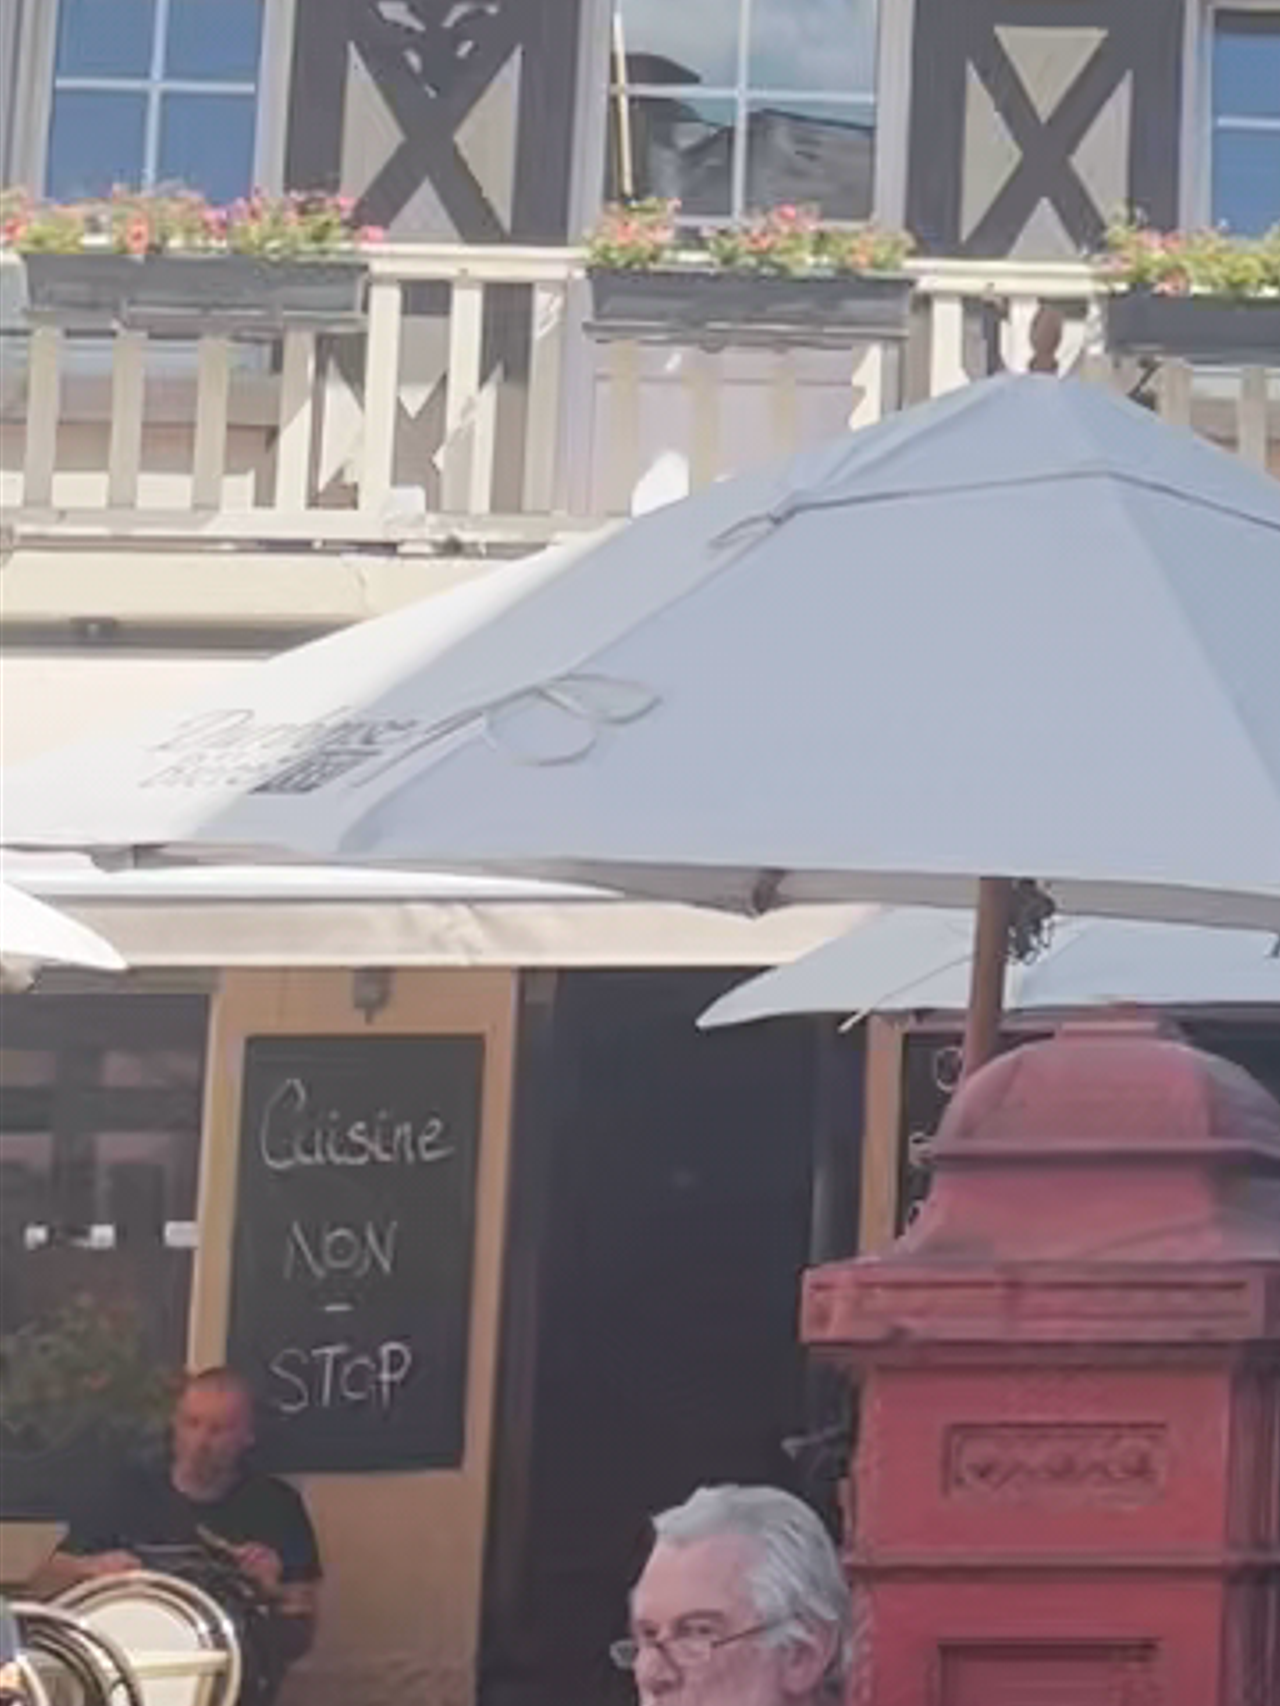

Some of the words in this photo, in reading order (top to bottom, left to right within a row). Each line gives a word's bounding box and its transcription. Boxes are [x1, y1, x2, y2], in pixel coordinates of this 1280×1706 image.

[261, 1077, 456, 1170] Cuisine
[284, 1220, 397, 1279] NON
[270, 1341, 412, 1412] STOP
